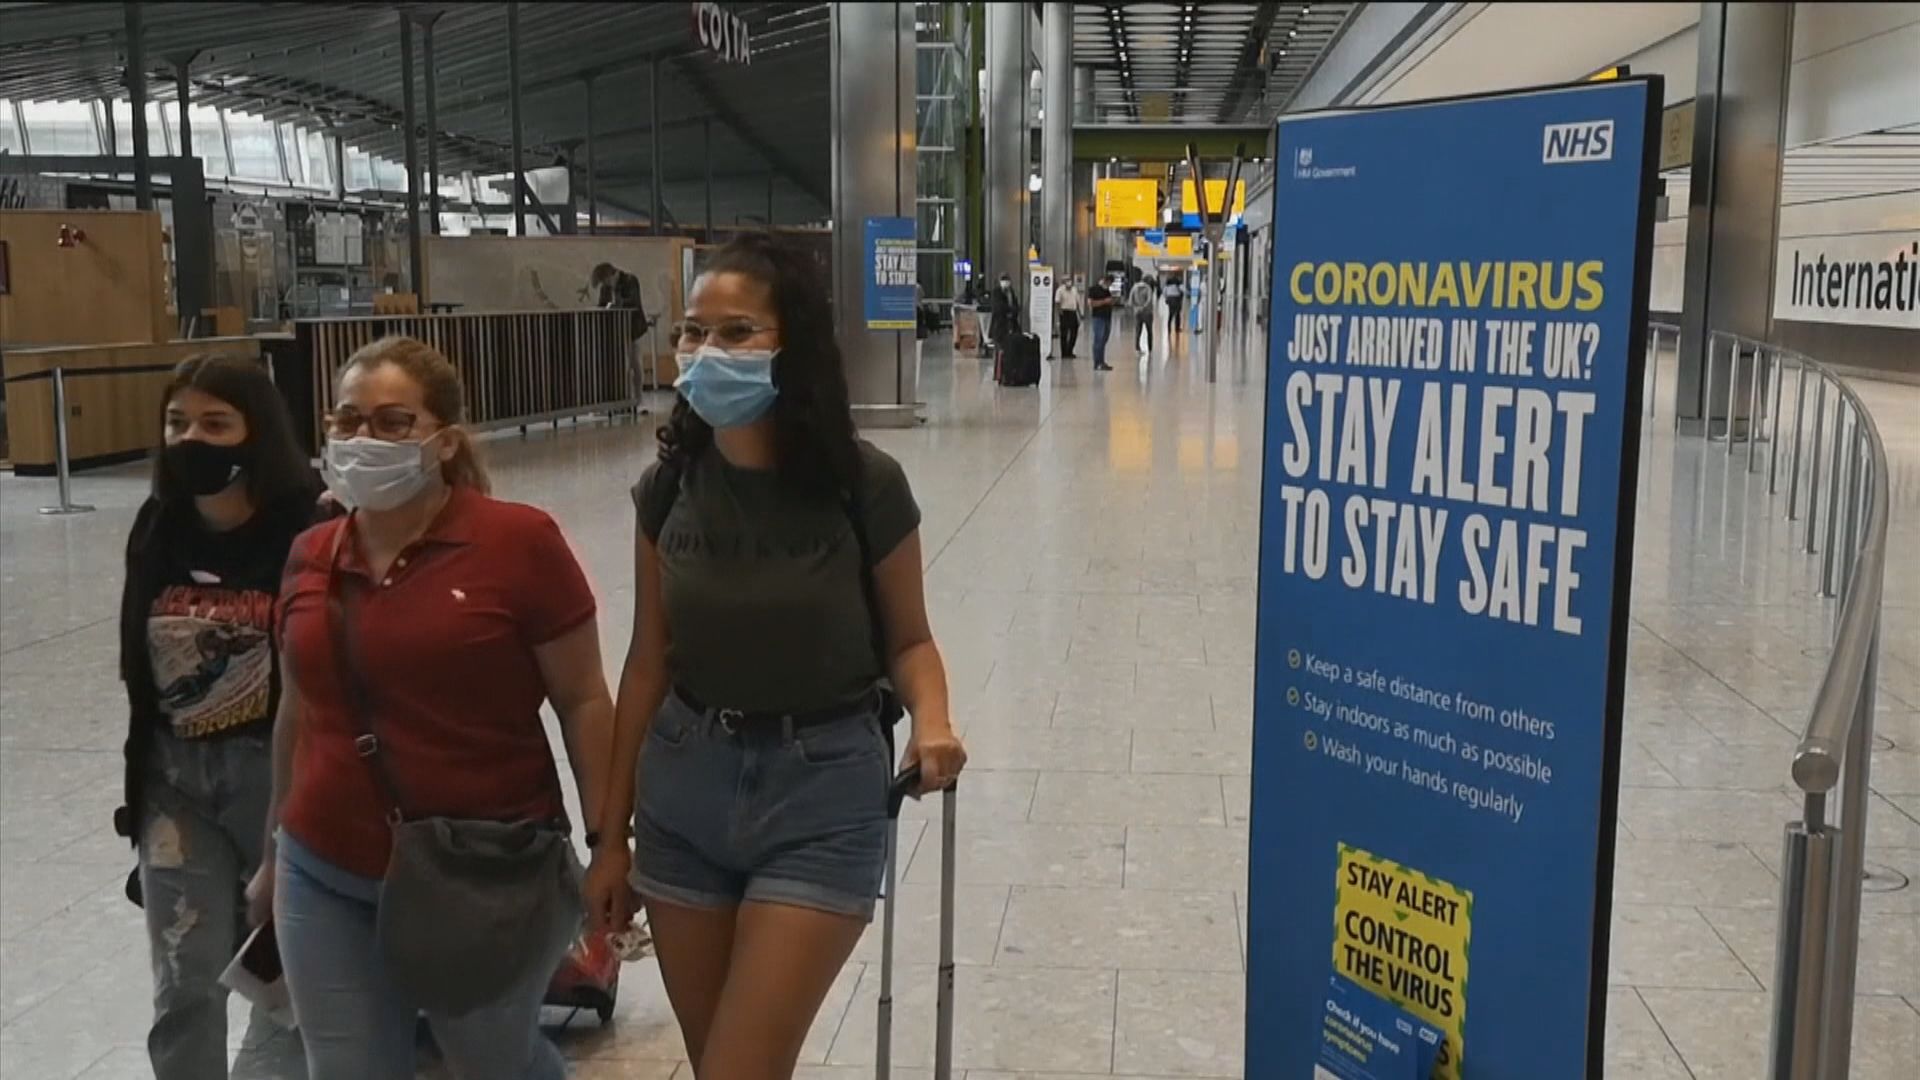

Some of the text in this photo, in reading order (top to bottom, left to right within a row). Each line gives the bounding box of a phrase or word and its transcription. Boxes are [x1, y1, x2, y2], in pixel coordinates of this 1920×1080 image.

[697, 2, 750, 66] COSTA
[1546, 124, 1611, 159] NHS
[875, 252, 900, 272] STAY
[1289, 260, 1605, 311] CORONAVIRUS
[1791, 241, 1920, 312] Internati
[1287, 313, 1601, 381] JUST ARRIVED IN THE UK?
[1282, 370, 1596, 518] STAY ALERT
[1281, 485, 1588, 636] TO STAY SAFE
[1306, 653, 1556, 740] Keep a safe distance from others
[1304, 691, 1553, 784] Stay indoors as much as possible
[1322, 735, 1524, 824] Wash your hands regularly
[1347, 861, 1459, 927] STAY ALERT
[1344, 943, 1454, 1018] THE VIRUS
[1345, 910, 1455, 984] CONTROL
[1360, 1023, 1377, 1041] you
[1378, 1031, 1400, 1055] have
